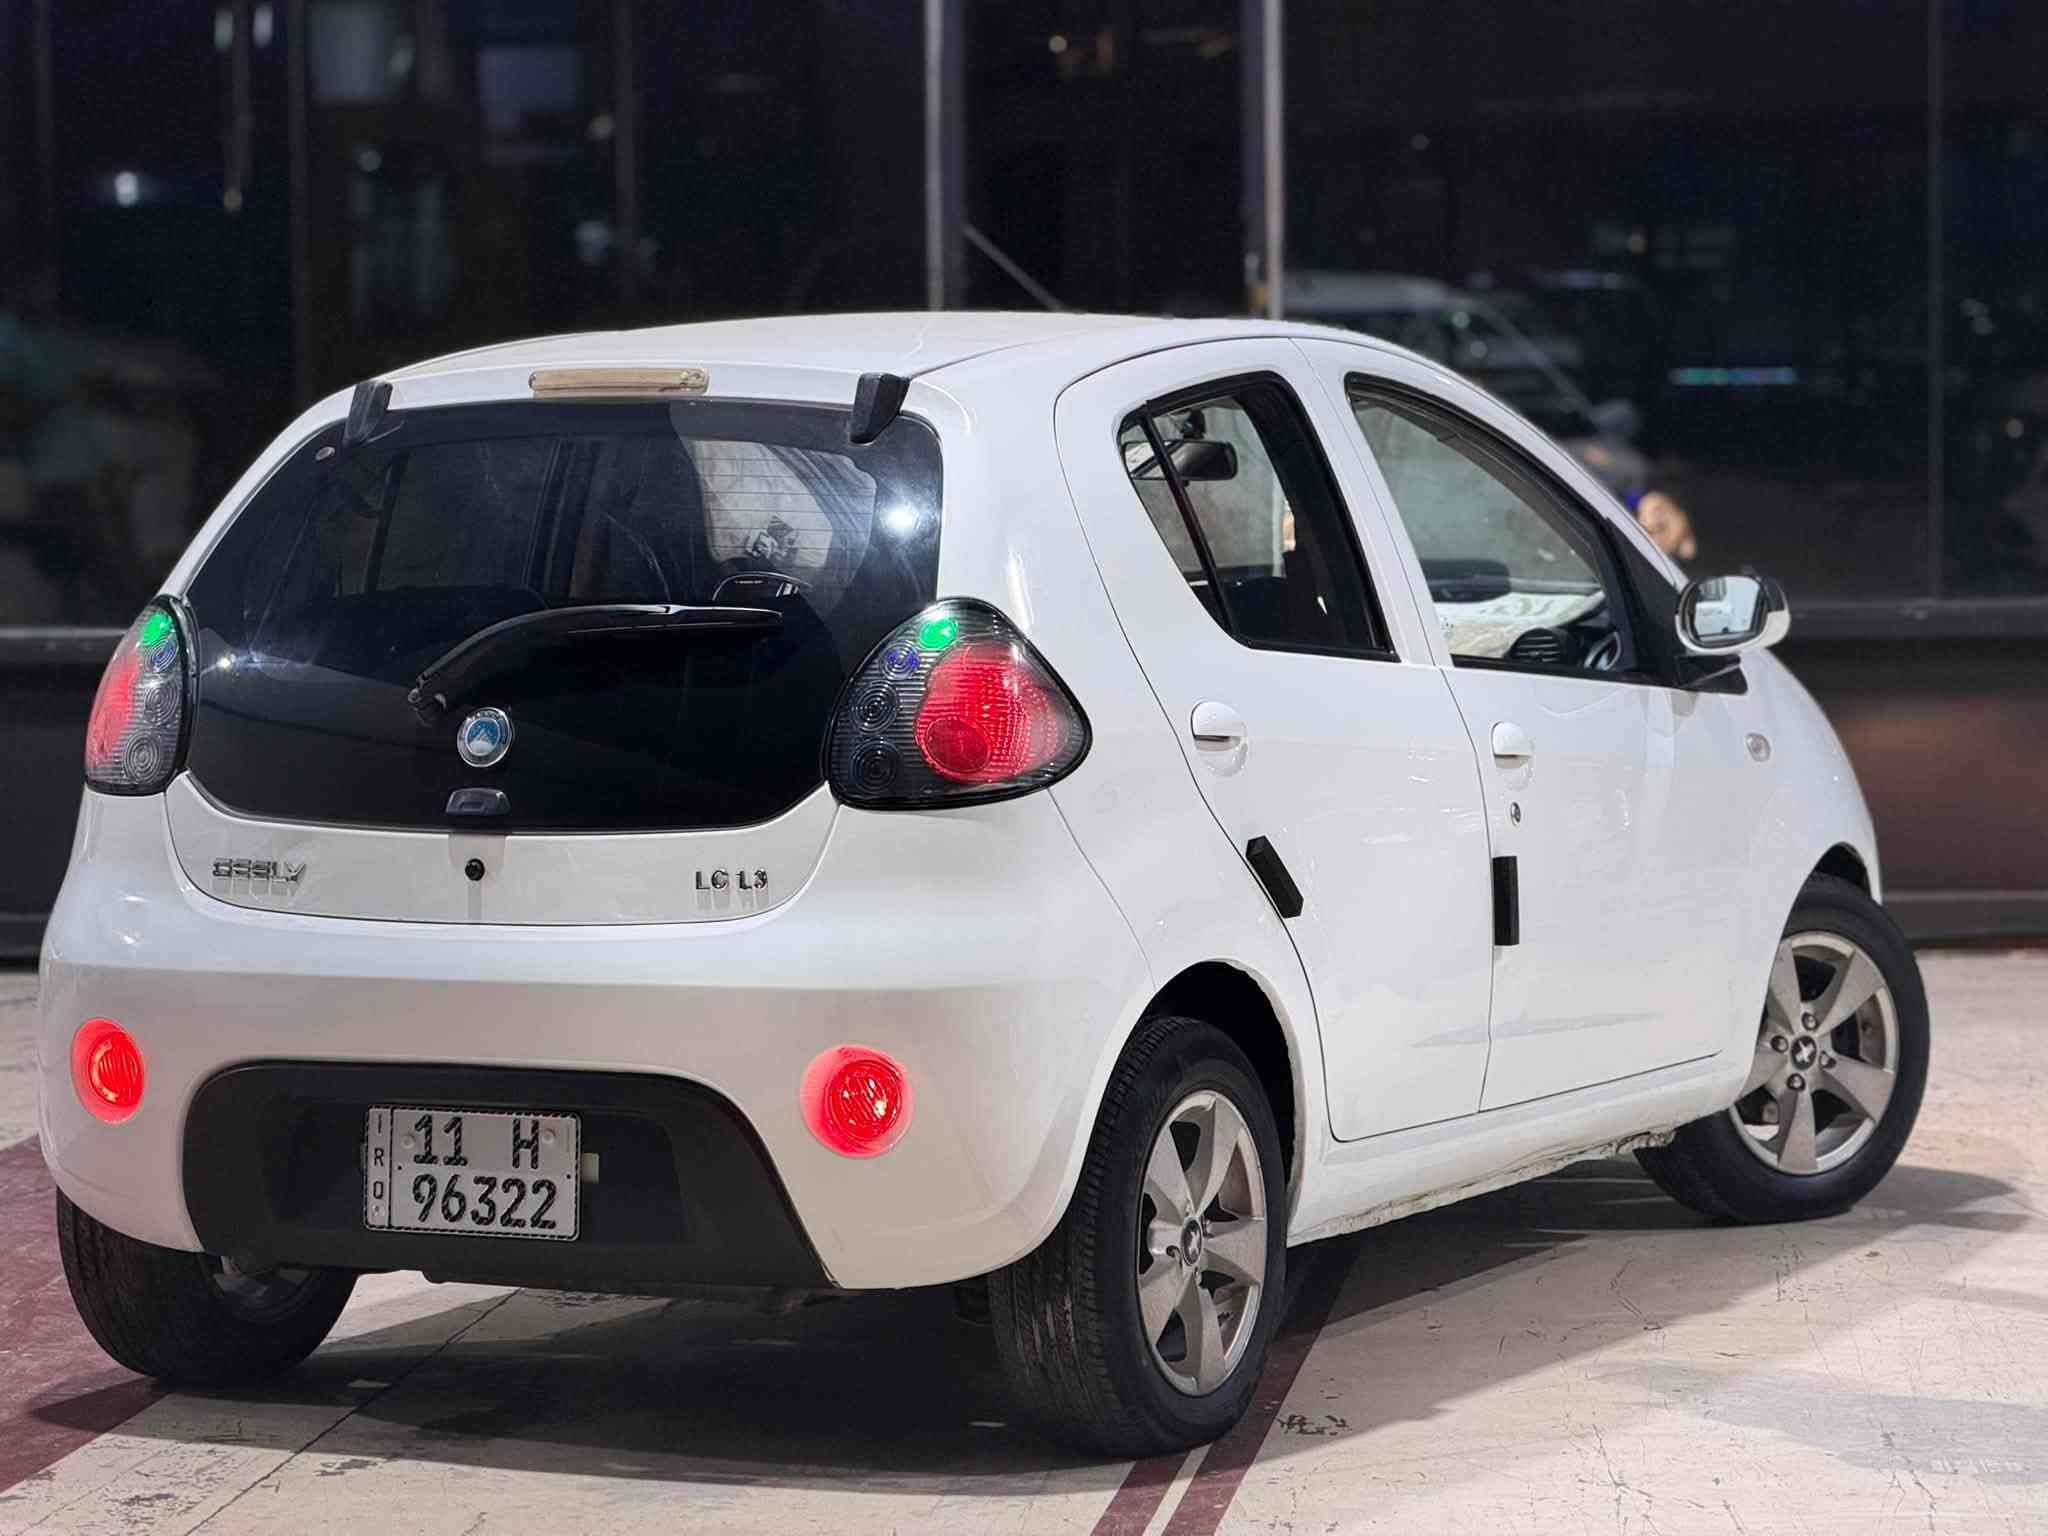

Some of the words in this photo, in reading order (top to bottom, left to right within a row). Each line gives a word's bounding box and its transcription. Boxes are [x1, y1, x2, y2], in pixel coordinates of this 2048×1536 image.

[413, 1114, 469, 1166] 11
[512, 1118, 540, 1169] H
[411, 1173, 557, 1229] 96322
